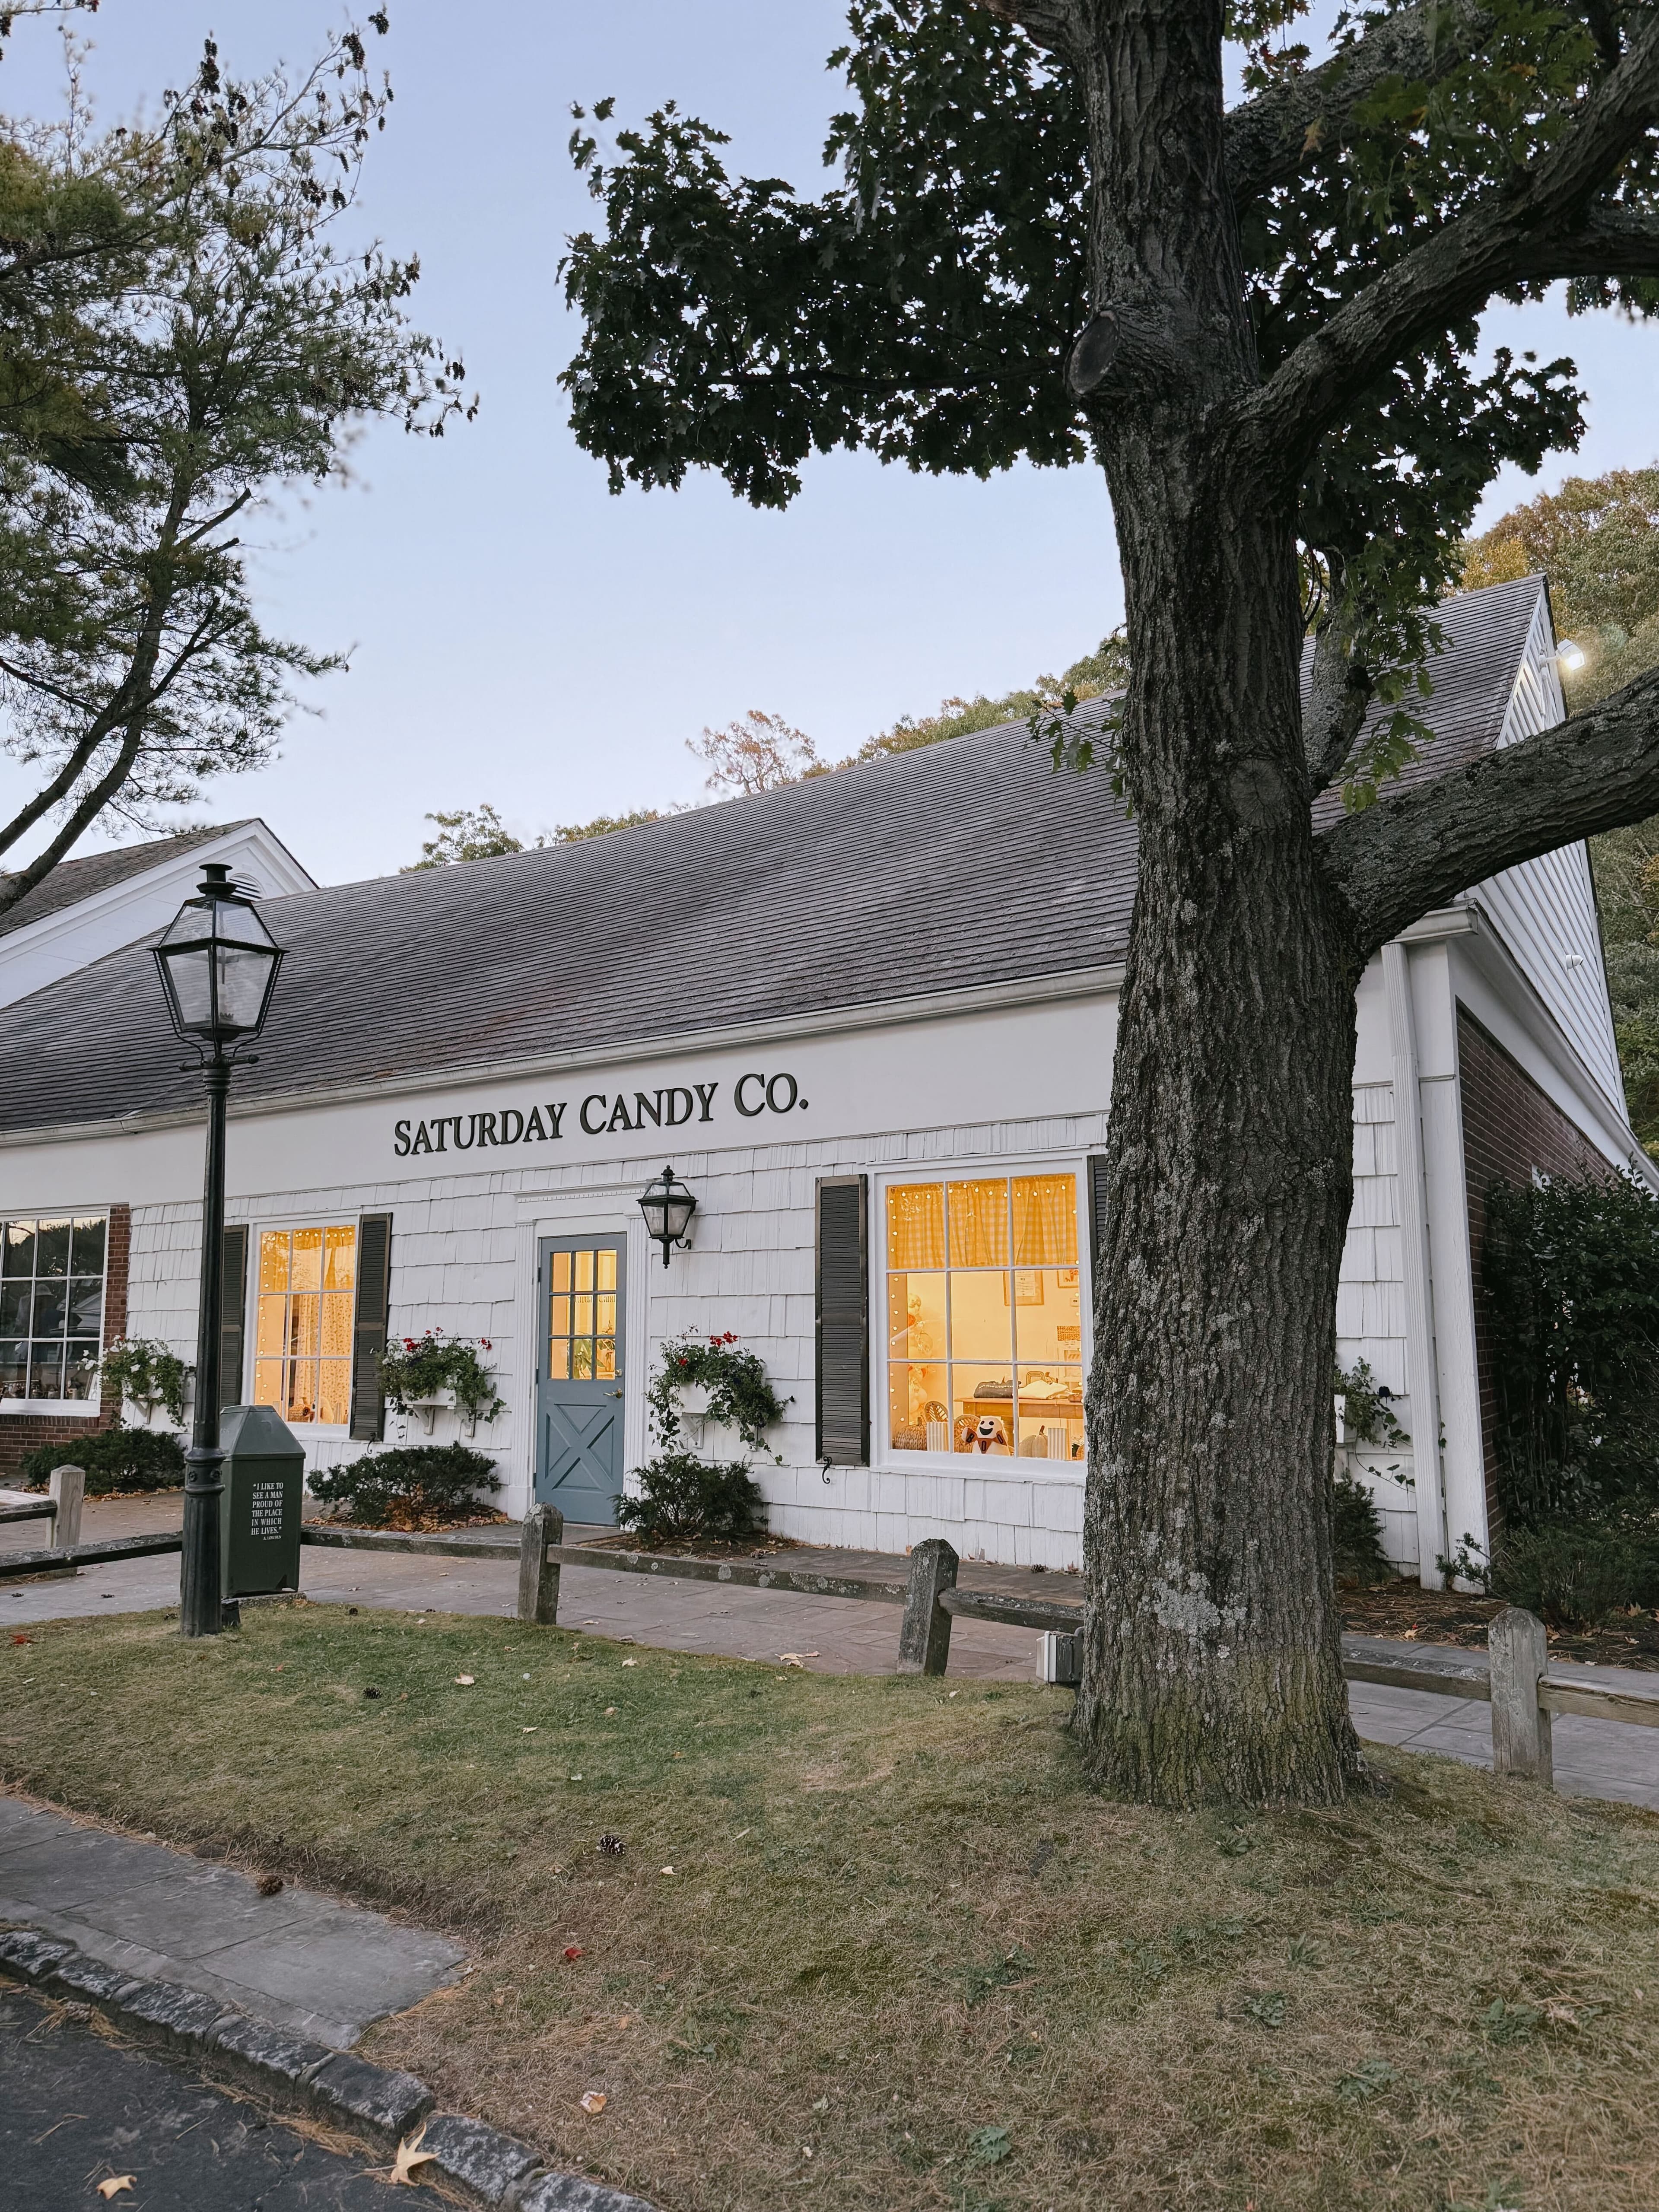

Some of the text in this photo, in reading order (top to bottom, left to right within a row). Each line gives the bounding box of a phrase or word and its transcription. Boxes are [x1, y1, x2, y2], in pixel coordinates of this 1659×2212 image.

[394, 1073, 809, 1157] SATURDAY CANDY CO.
[261, 1517, 282, 1526] WHICH
